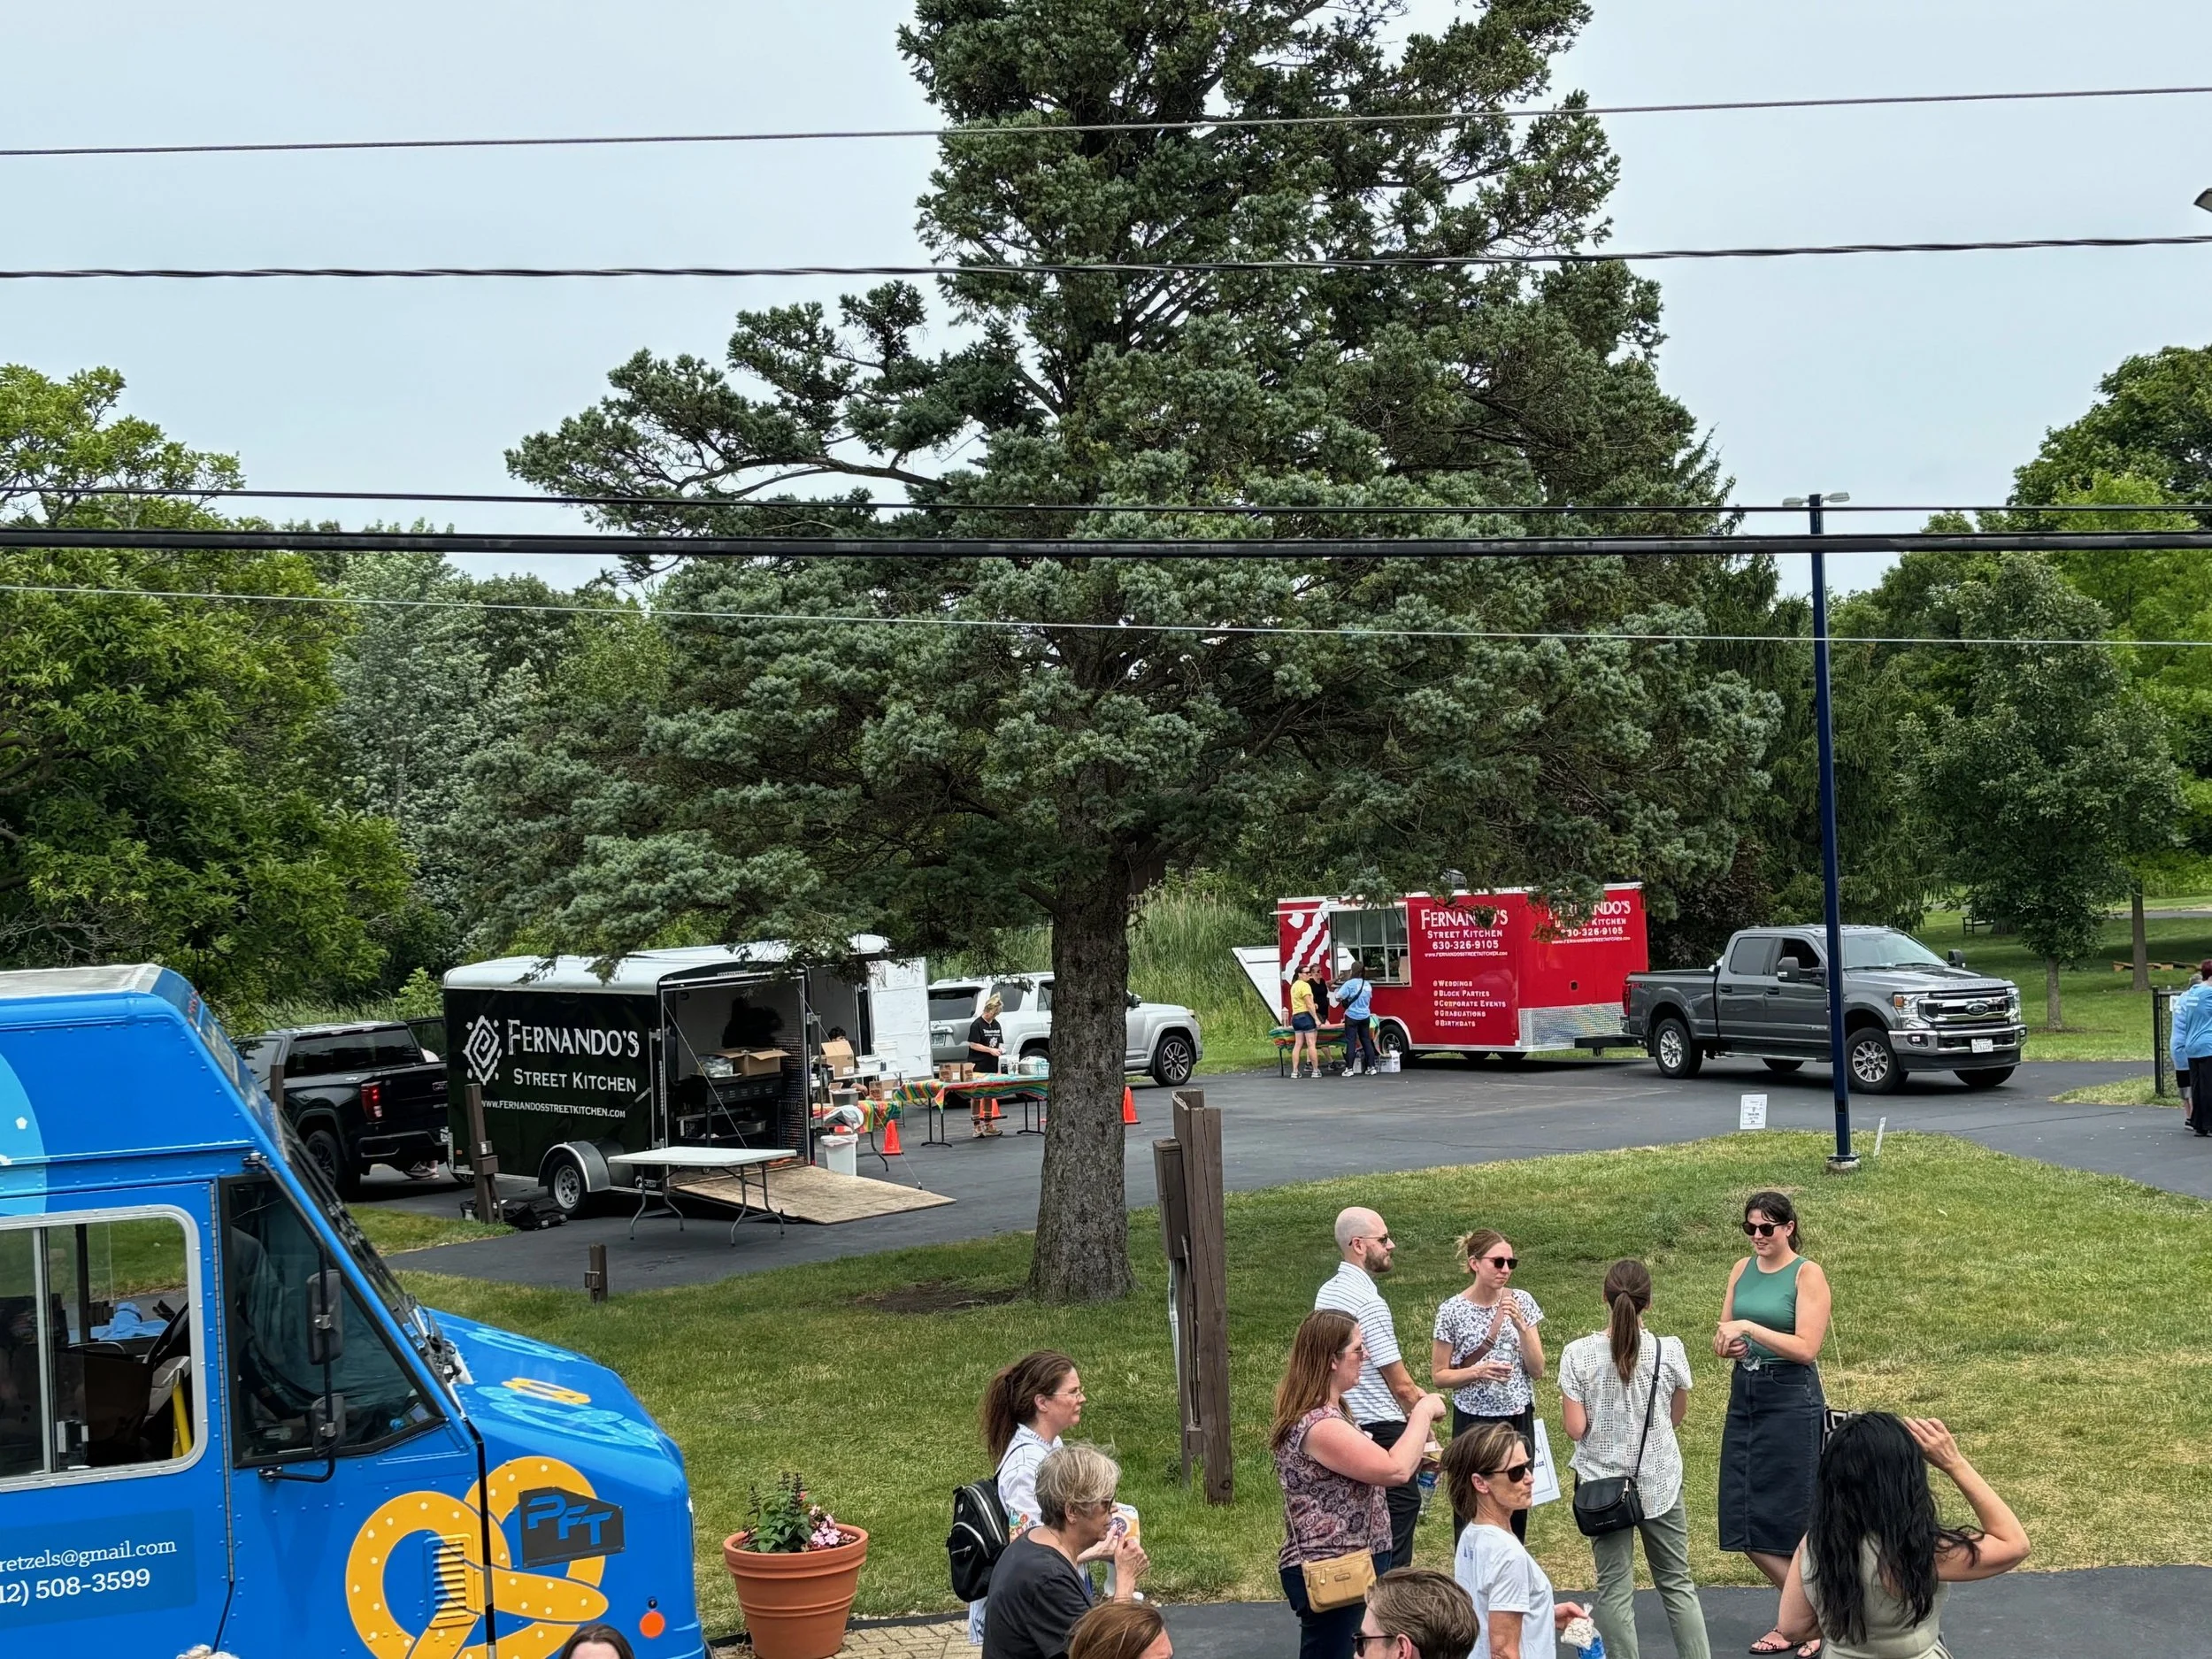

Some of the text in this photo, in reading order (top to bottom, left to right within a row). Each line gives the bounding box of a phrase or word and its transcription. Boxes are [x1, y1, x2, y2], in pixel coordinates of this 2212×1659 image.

[1427, 929, 1503, 939] STREET KITCHEN
[1591, 918, 1626, 926] KITCHEN
[1432, 940, 1499, 950] 630-326-9105
[507, 1018, 640, 1058] FERNANDO'S
[513, 1068, 636, 1093] STREET KITCHEN
[527, 1494, 614, 1546] PFT
[35, 1568, 150, 1599] 508-3599
